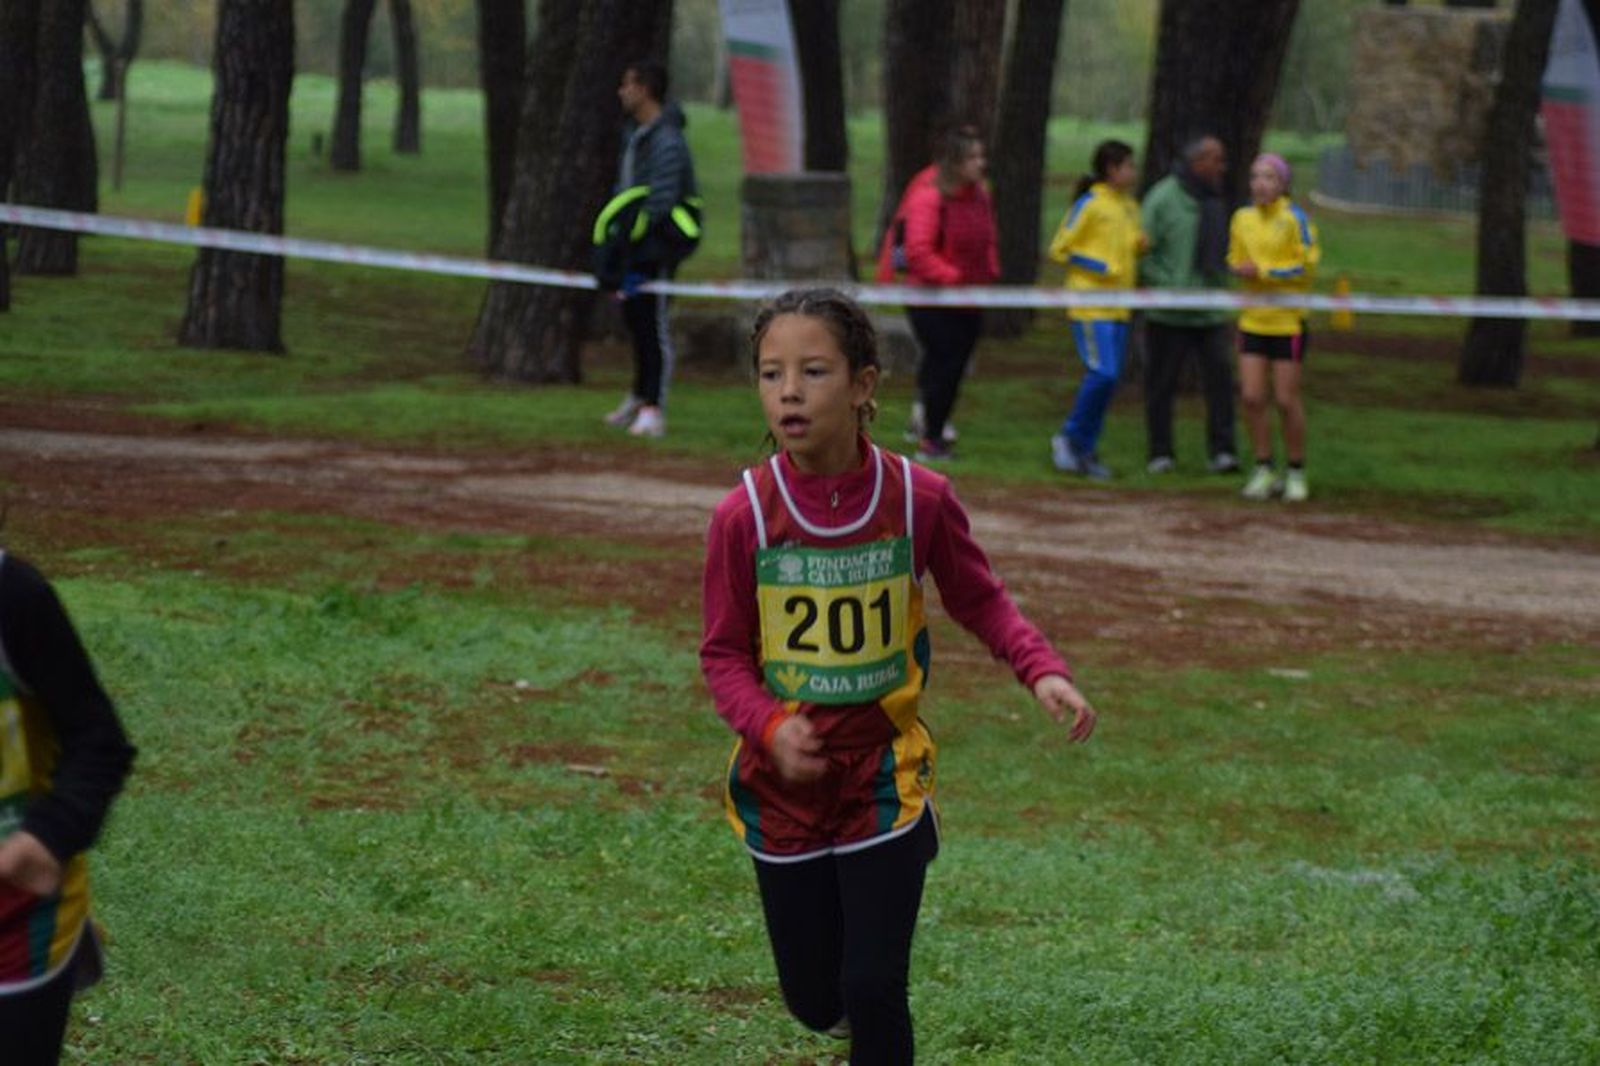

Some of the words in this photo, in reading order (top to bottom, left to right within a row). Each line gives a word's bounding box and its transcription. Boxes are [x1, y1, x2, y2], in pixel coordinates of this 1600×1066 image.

[807, 570, 843, 584] CAJA
[784, 588, 891, 655] 201
[809, 674, 852, 693] CAJA
